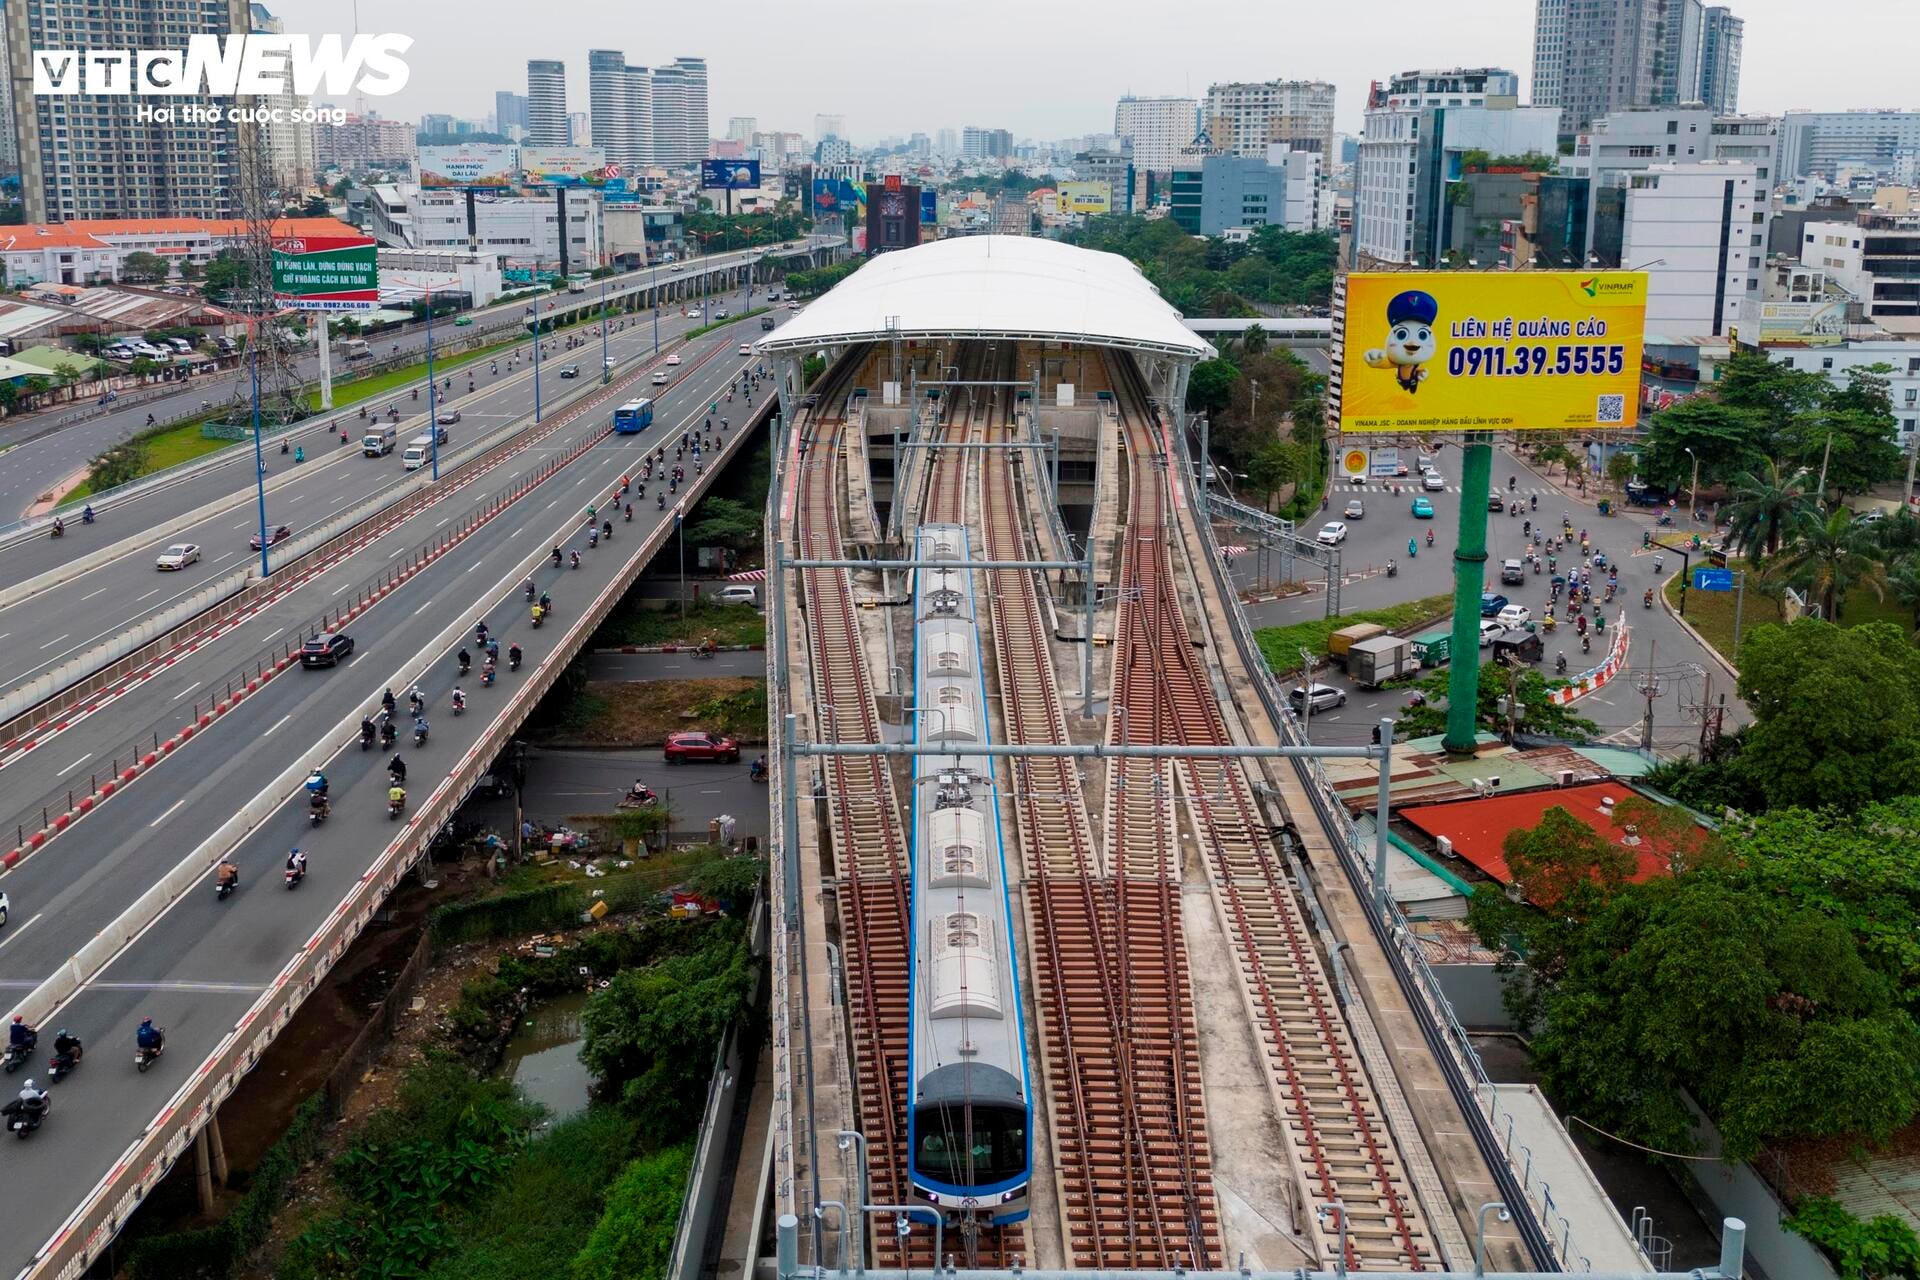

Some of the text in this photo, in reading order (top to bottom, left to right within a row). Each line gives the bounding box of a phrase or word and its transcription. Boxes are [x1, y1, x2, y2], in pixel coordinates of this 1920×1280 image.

[319, 260, 336, 271] DỪNG
[336, 260, 354, 272] ĐÚNG
[355, 262, 372, 273] VẠCH
[321, 273, 339, 284] CÁCH
[340, 275, 349, 284] AN
[350, 274, 367, 285] TOÀN
[1451, 316, 1606, 342] LIÊN HỆ QUẢNG CÁO
[1449, 345, 1624, 375] 0911.39.5555
[1418, 418, 1440, 426] NGHIỆP
[1441, 417, 1458, 426] HÀNG
[1472, 416, 1487, 425] LĨNH
